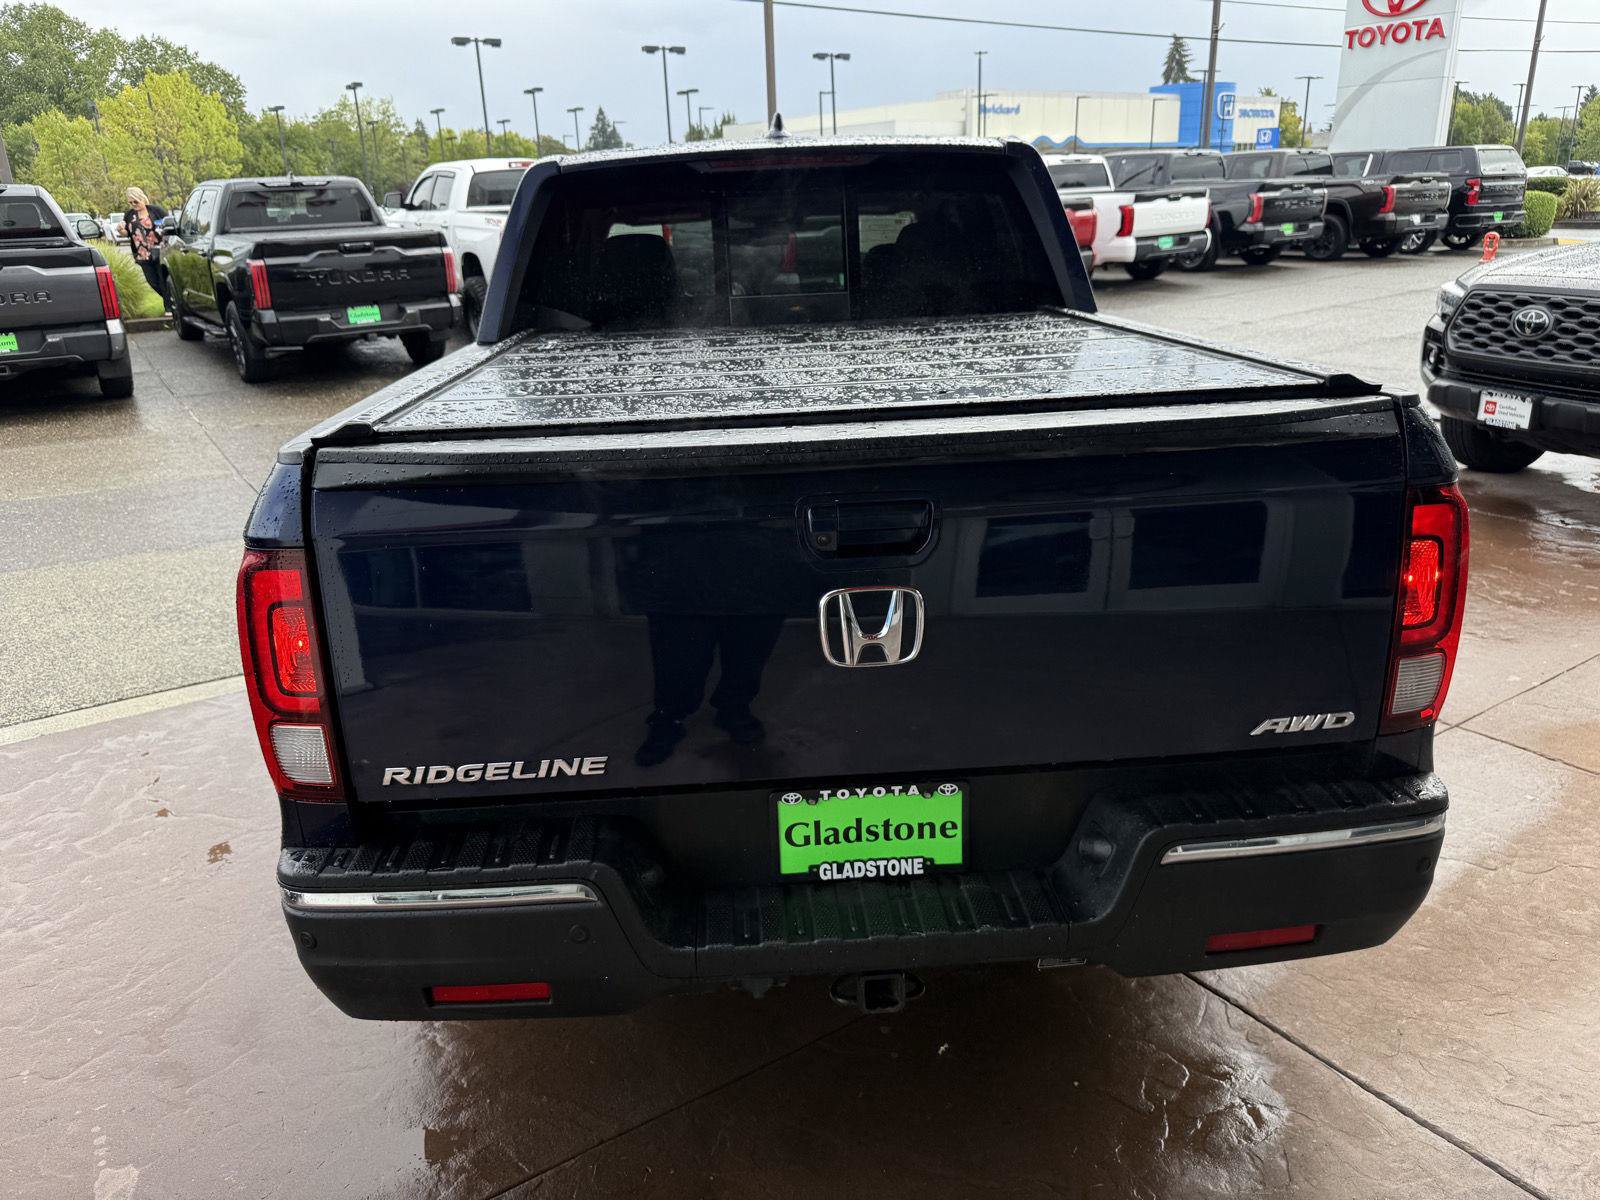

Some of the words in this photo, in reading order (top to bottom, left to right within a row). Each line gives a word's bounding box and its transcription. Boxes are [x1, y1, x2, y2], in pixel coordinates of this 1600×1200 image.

[1345, 18, 1445, 49] TOYOTA
[1249, 711, 1355, 736] AWD
[382, 756, 608, 786] RIDGELINE
[819, 785, 920, 801] TOYOTA
[784, 817, 958, 848] Gladstone
[819, 857, 924, 880] GLADSTONE
